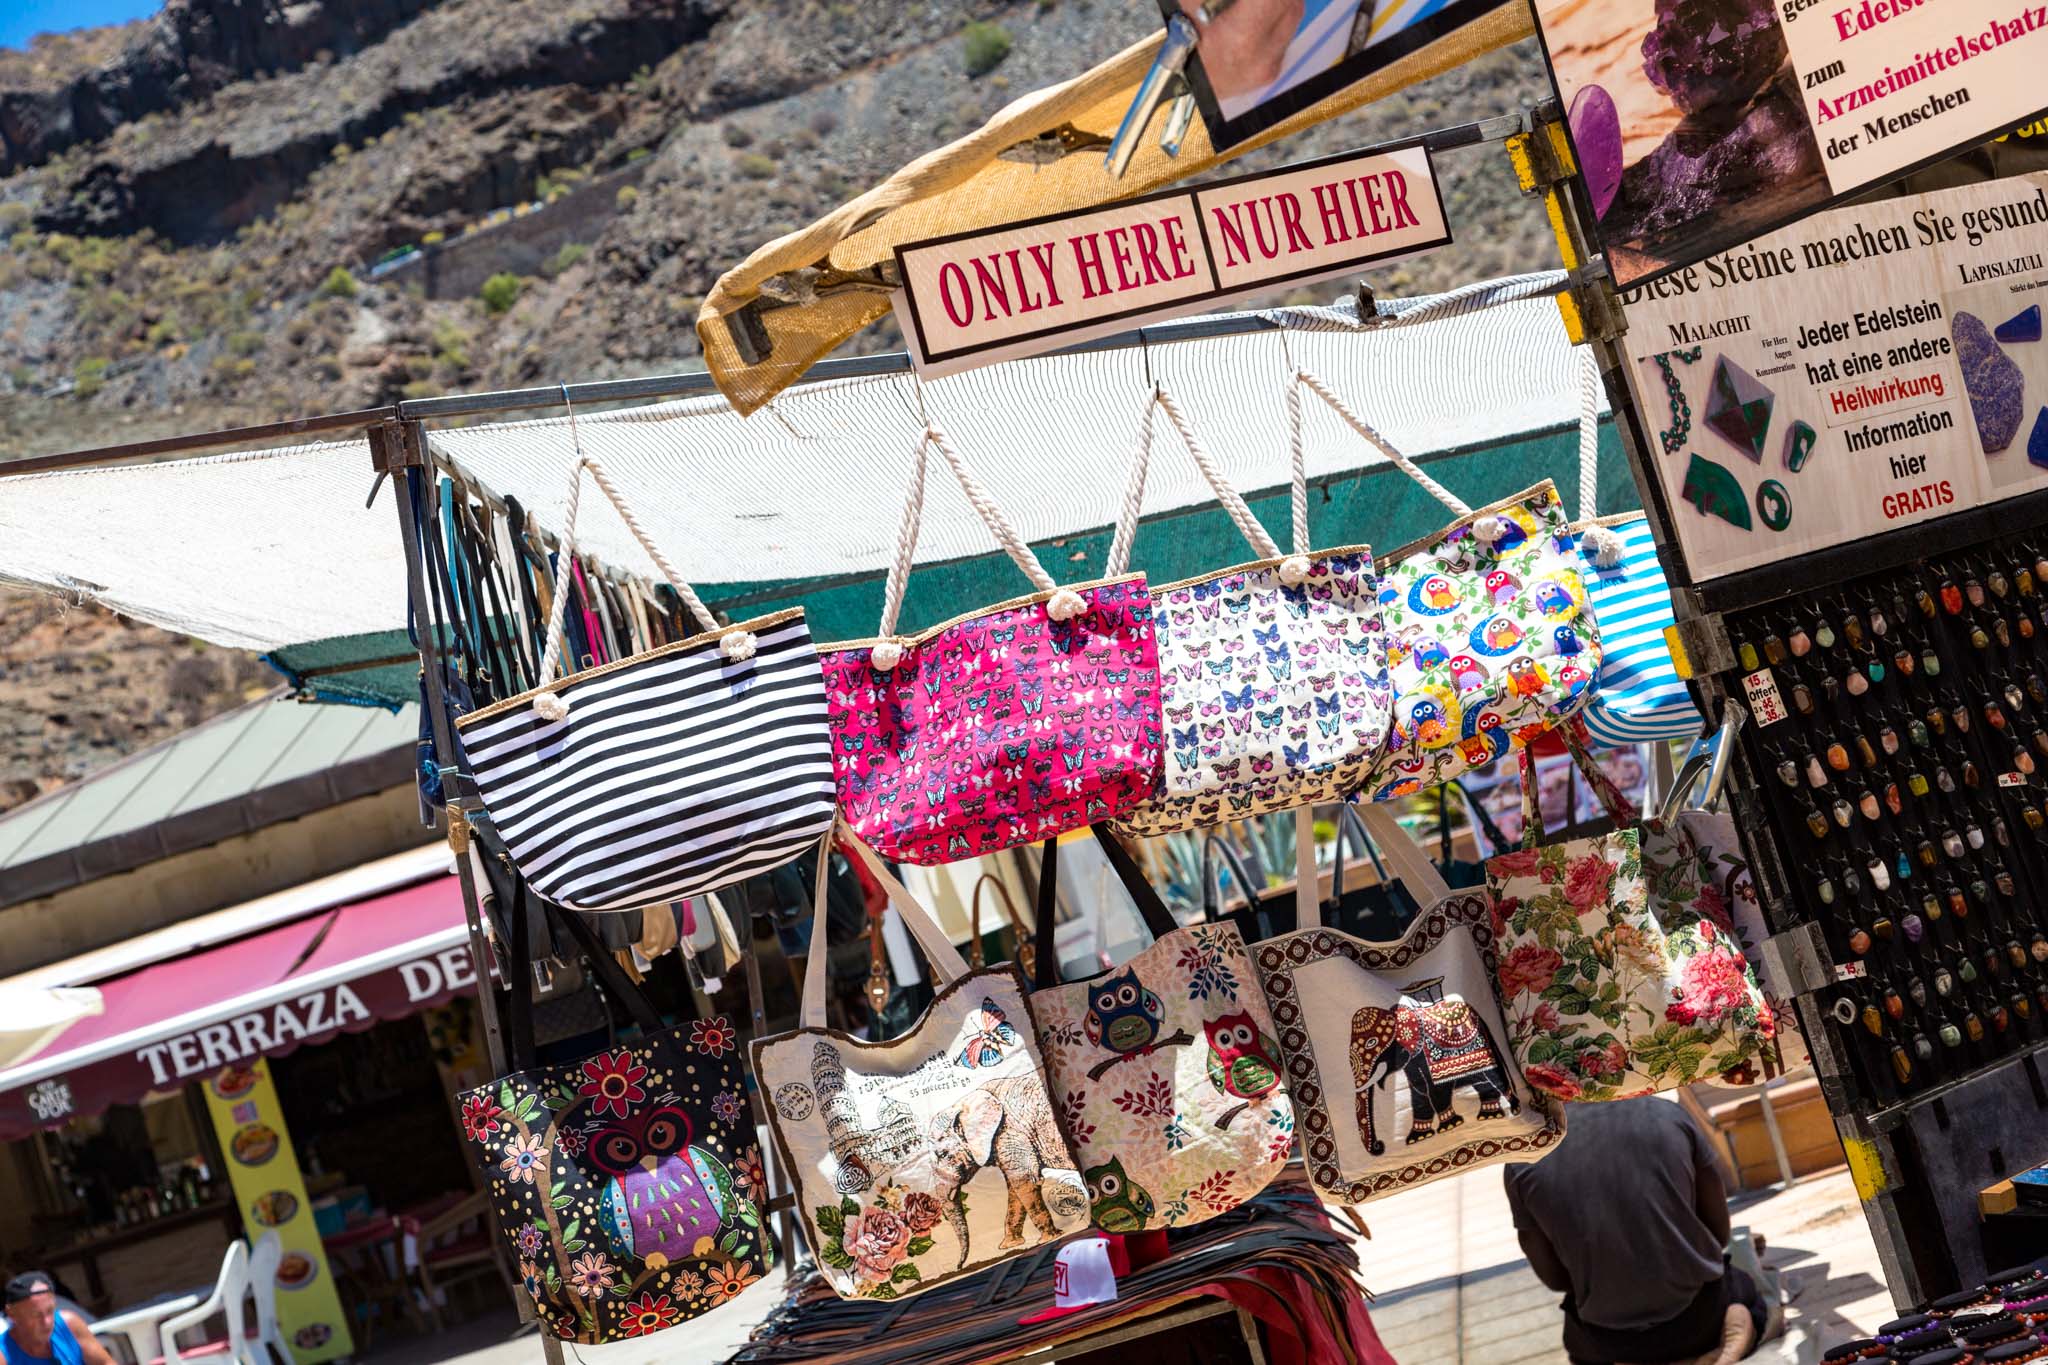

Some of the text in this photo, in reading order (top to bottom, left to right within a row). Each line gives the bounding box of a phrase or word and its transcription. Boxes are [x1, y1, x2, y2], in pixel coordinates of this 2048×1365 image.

[1831, 0, 1931, 42] Edels
[1803, 59, 1846, 90] zum
[1816, 5, 2048, 126] Arzneimittelschatz
[1826, 132, 1860, 160] der
[1863, 87, 1971, 145] Menschen
[1212, 169, 1421, 267] NUR HIER
[1703, 243, 1796, 288] Steine
[1800, 223, 1912, 270] machen
[1912, 208, 1957, 247] Sie
[1961, 187, 2048, 247] gesund
[938, 215, 1196, 328] ONLY HERE
[1957, 253, 2045, 285] LAPISLAZULI
[1667, 315, 1752, 346] MALACHIT
[1797, 299, 1942, 349] Jeder Edelstein
[1805, 336, 1951, 385] hat eine andere
[1830, 372, 1945, 415] Heilwirkung
[1844, 410, 1954, 453] Information
[1889, 454, 1927, 479] hier
[1882, 480, 1955, 519] GRATIS
[1749, 684, 1777, 702] Offert
[136, 983, 371, 1086] TERRAZA
